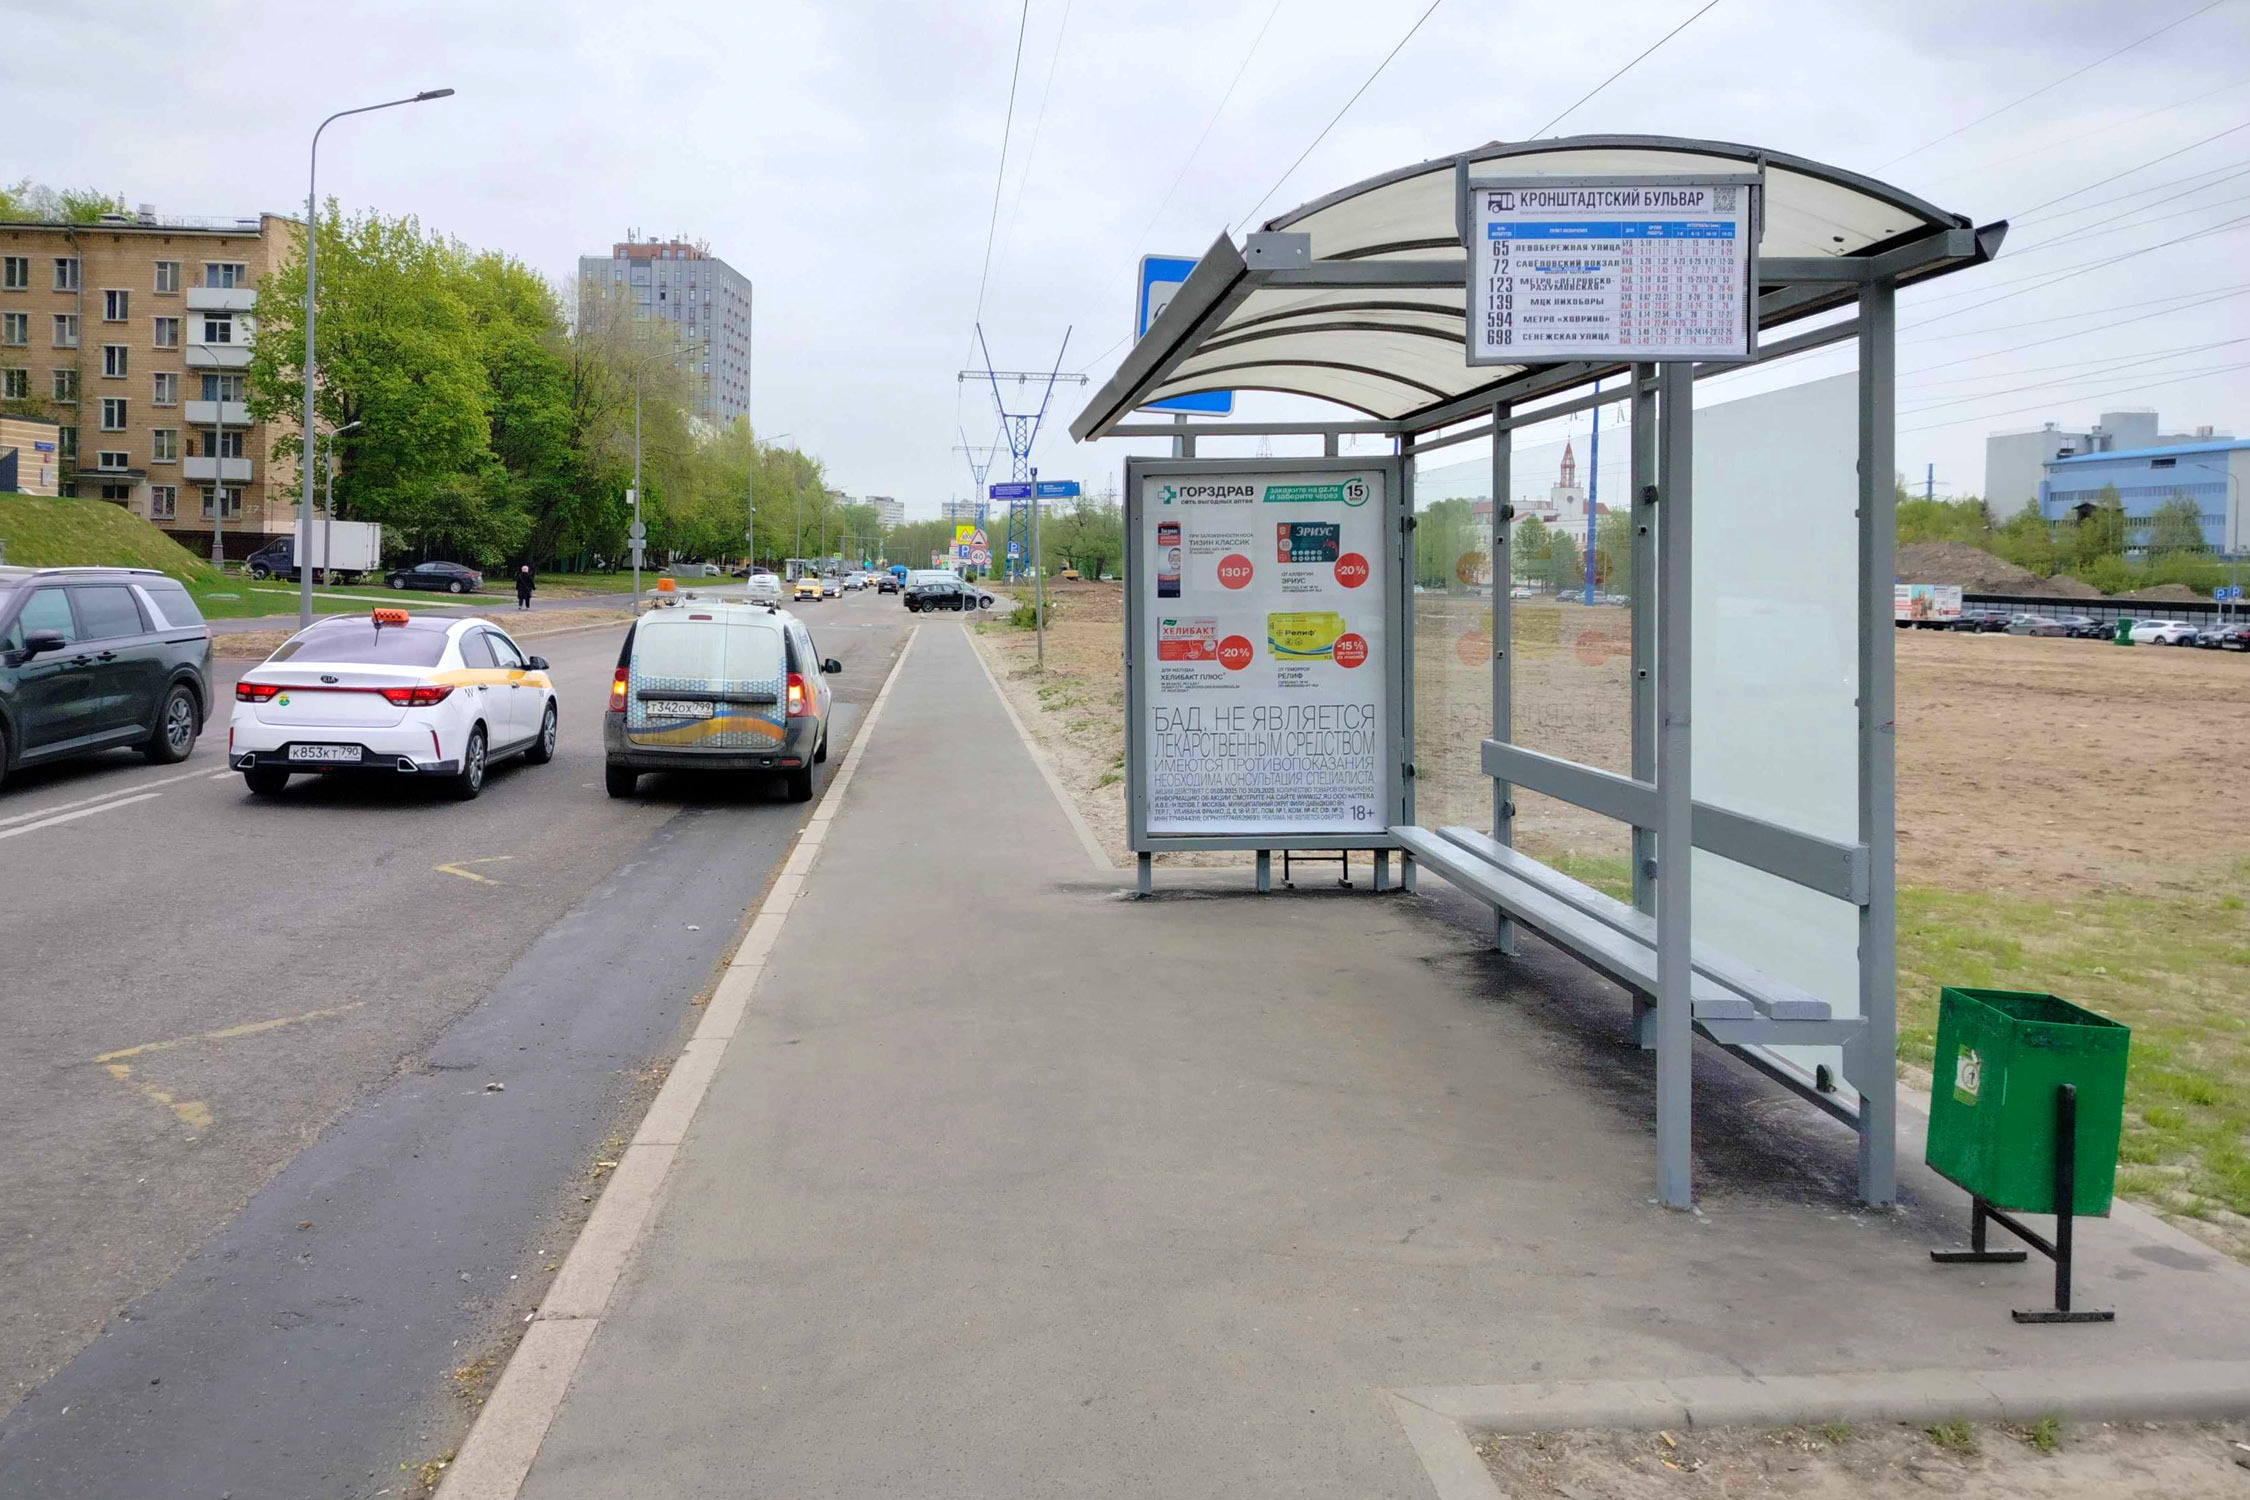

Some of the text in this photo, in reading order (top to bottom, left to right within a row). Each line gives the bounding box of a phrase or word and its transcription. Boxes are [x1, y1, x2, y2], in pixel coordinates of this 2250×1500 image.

[1520, 188, 1704, 208] КРОНШТАДТСКИЙ БУЛЬВАР
[1493, 241, 1509, 256] 65
[1515, 243, 1621, 252] ЛЕВОБЕРЕЖНАЯ УЛИЦА
[1493, 259, 1509, 274] 72
[1584, 259, 1619, 267] ВОКЗАЛ
[1489, 277, 1513, 293] 123
[1489, 295, 1512, 310] 139
[1488, 312, 1512, 327] 594
[1487, 329, 1512, 345] 698
[1180, 486, 1254, 498] ГОРЗДРАВ
[1319, 487, 1337, 495] gz.ru
[1347, 485, 1363, 497] 15
[1296, 527, 1333, 536] ЭРИУС
[973, 552, 984, 560] 40
[651, 702, 710, 713] Т342ОХ 799
[1216, 706, 1245, 731] НЕ
[1253, 704, 1375, 730] ЯВЛЯЕТСЯ
[1155, 730, 1375, 757] ЛЕКАРСТВЕННЫМ СРЕДСТВОМ
[293, 747, 338, 758] К853КТ
[341, 747, 359, 756] 790
[1155, 756, 1374, 772] ИМЕЮТСЯ ПРОТИВОПОКАЗАНИЯ
[1155, 771, 1374, 787] НЕОБХОДИМА КОНСУЛЬТАЦИЯ СПЕЦИАЛИСТА
[1350, 805, 1375, 820] 18+
